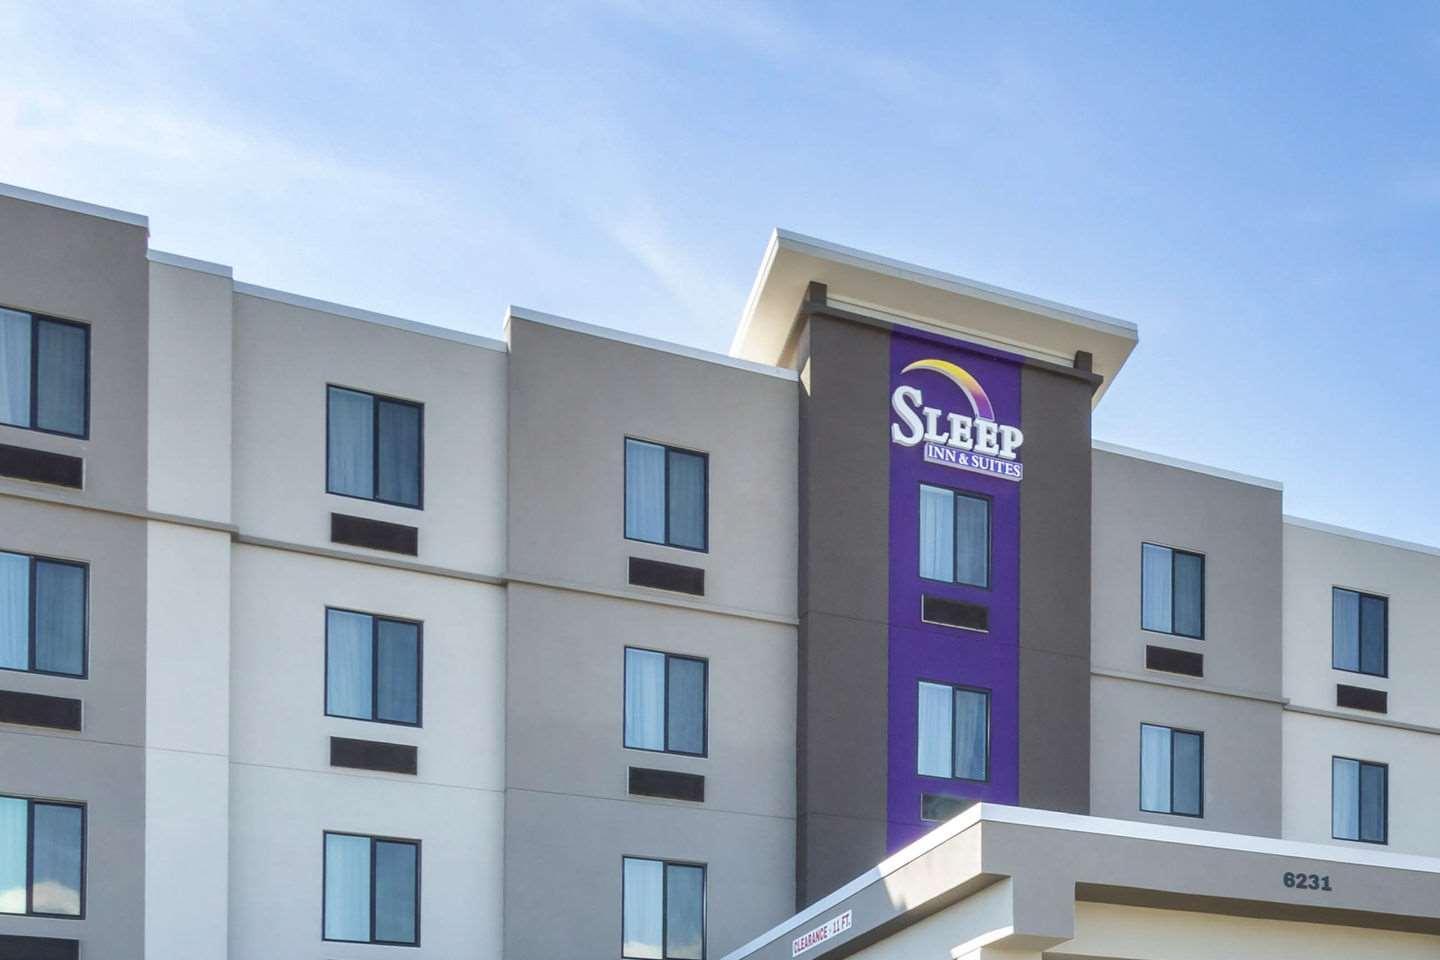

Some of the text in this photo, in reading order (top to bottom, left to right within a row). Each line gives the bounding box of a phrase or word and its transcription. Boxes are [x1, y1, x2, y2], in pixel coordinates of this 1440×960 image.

[891, 385, 1024, 460] SLEEP
[928, 444, 1022, 477] INN & SUITES
[1283, 871, 1332, 891] 6231
[794, 925, 828, 954] CLEARANCE
